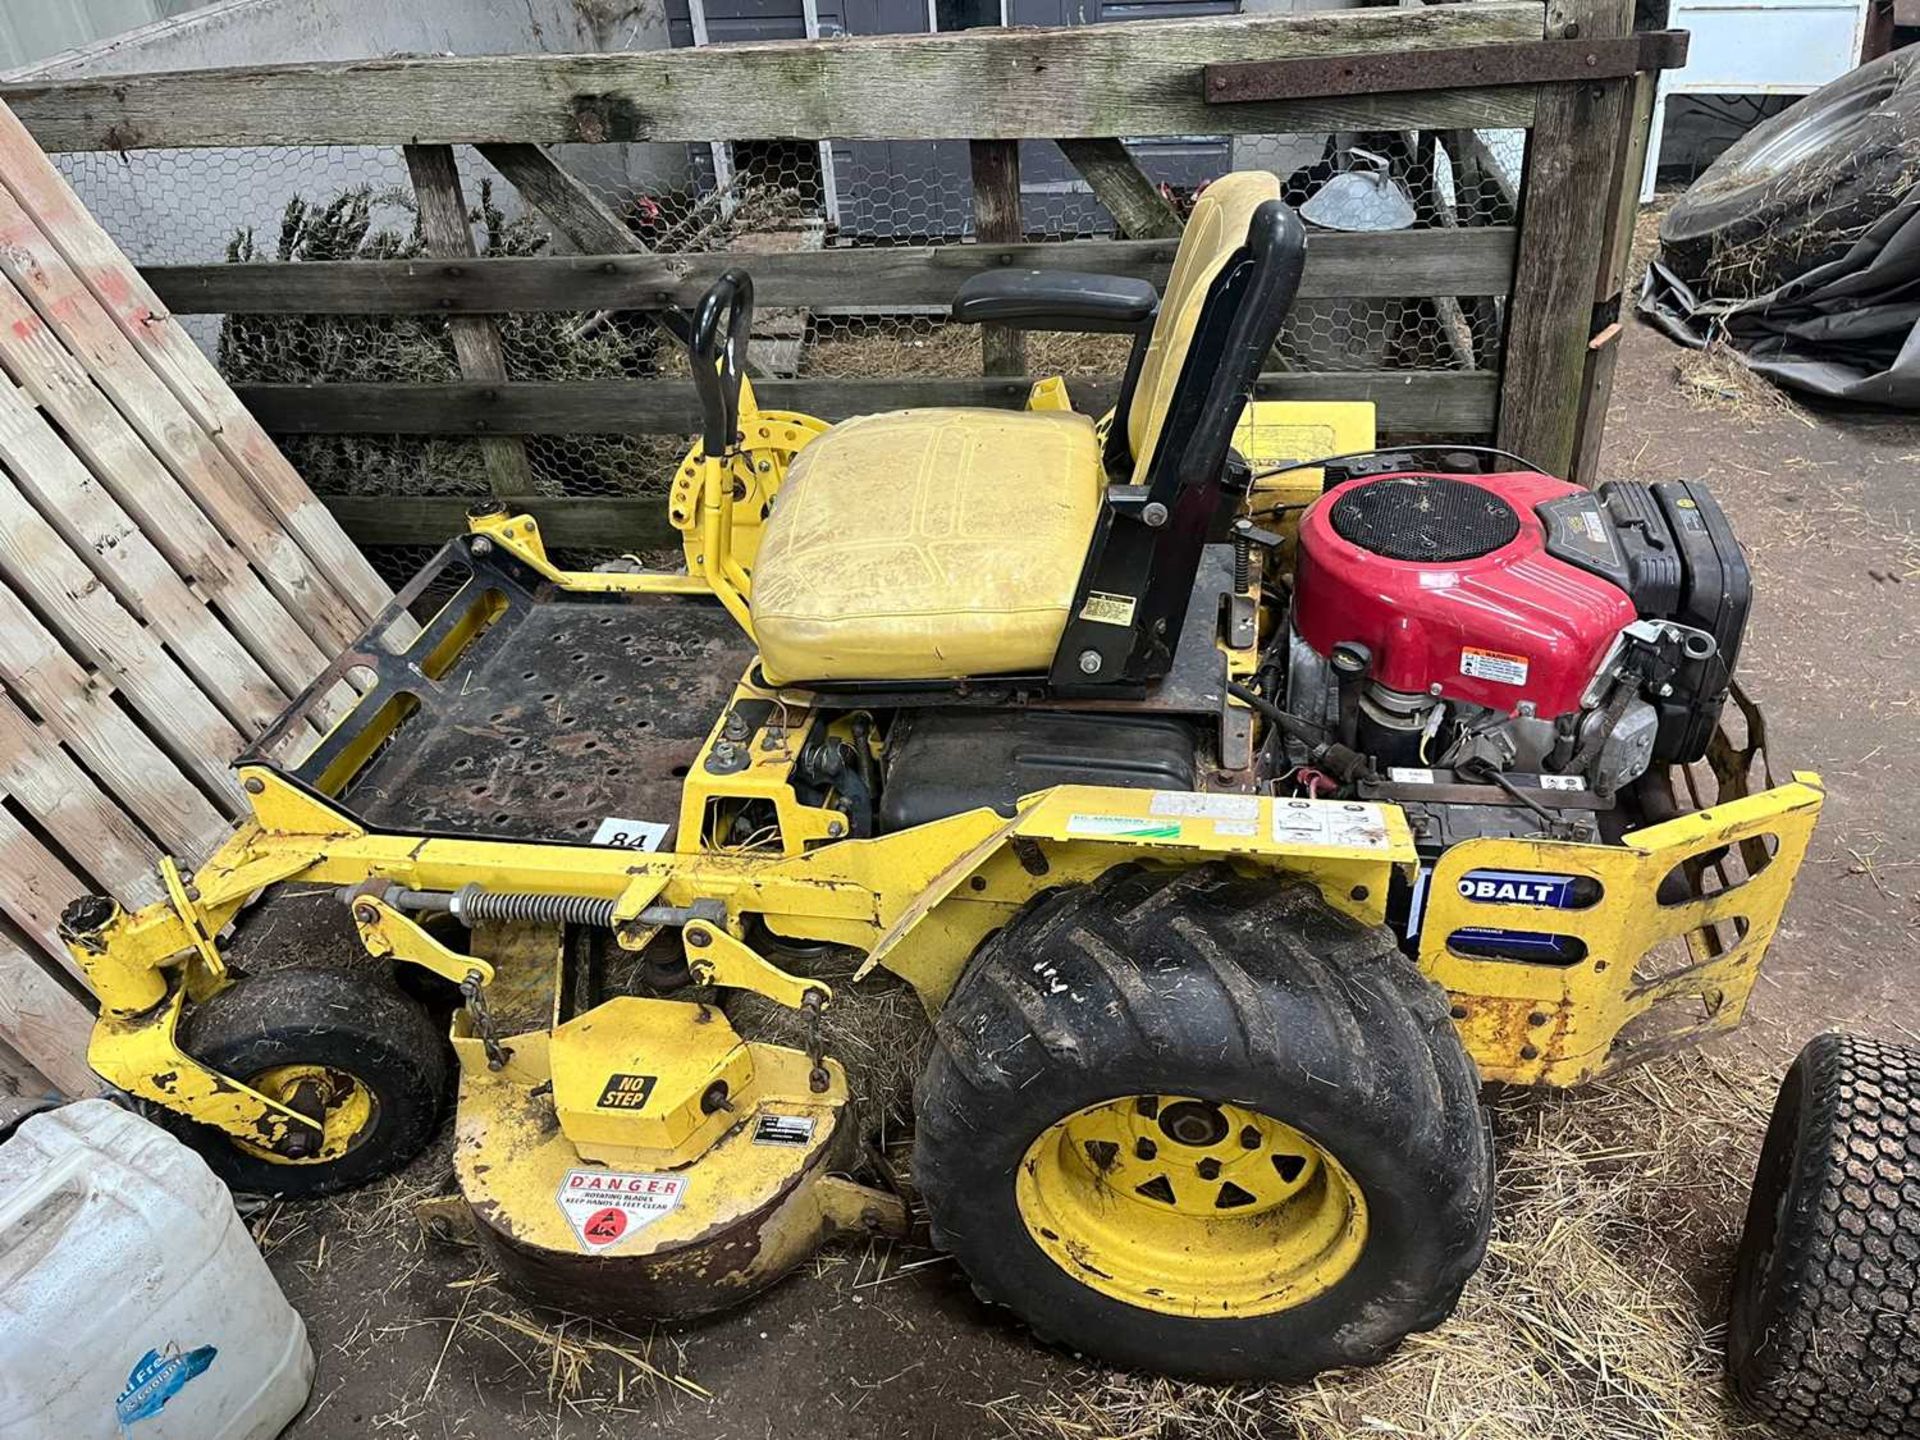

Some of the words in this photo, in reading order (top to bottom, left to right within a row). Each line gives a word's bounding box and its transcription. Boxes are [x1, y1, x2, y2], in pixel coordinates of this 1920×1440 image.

[609, 832, 648, 848] 84
[1458, 880, 1554, 901] OBALT
[618, 1077, 644, 1091] NO
[603, 1091, 644, 1106] STEP
[570, 1176, 677, 1194] DANGER
[584, 1192, 622, 1201] ROTATING
[136, 1356, 165, 1383] Fre
